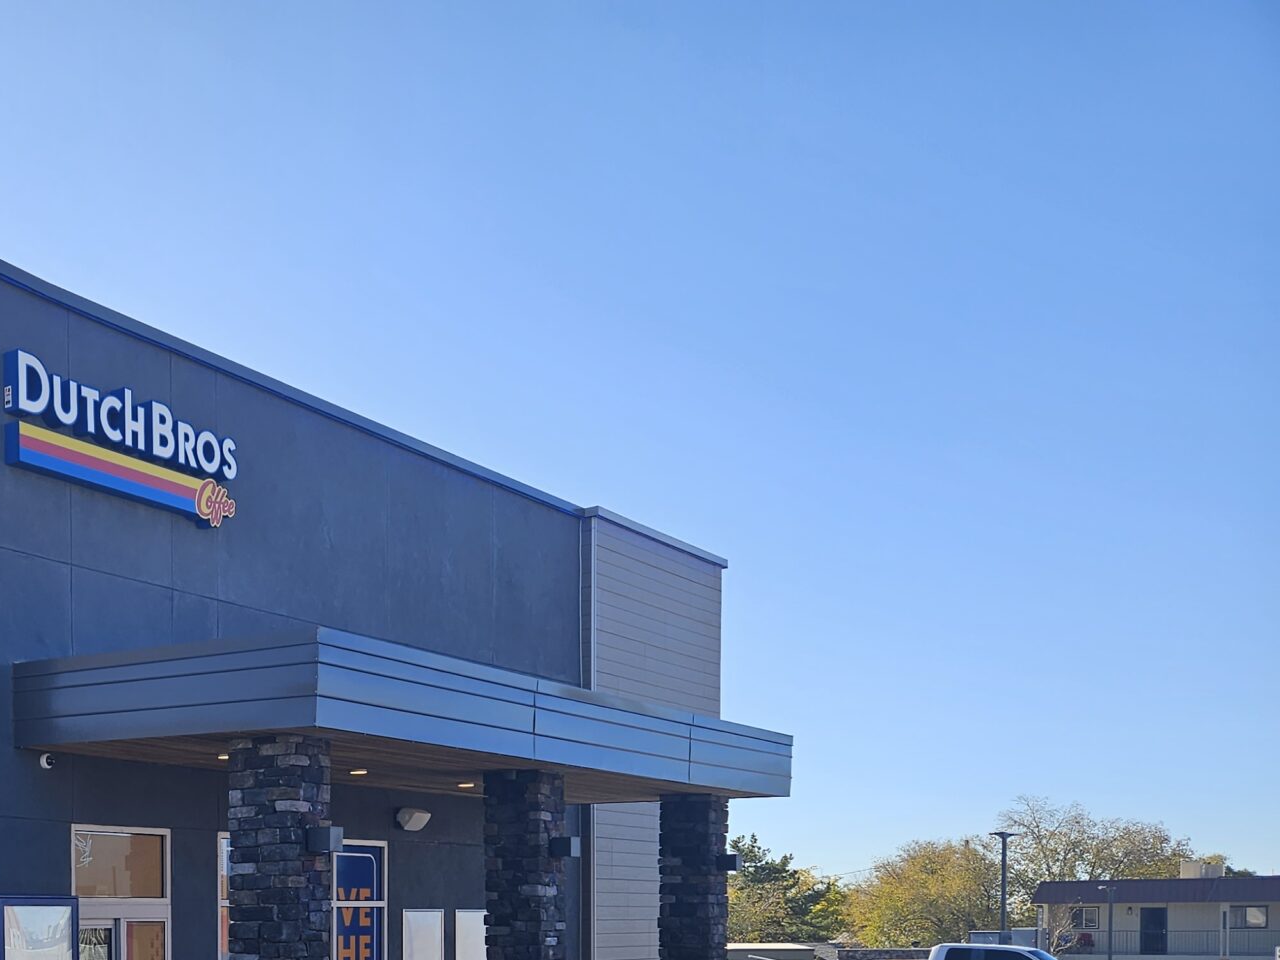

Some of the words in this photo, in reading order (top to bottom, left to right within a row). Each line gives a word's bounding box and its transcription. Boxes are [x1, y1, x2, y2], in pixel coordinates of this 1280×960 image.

[18, 350, 145, 451] DUTCH
[152, 401, 238, 480] BROS
[196, 478, 236, 527] Coffee
[337, 888, 372, 927] VE
